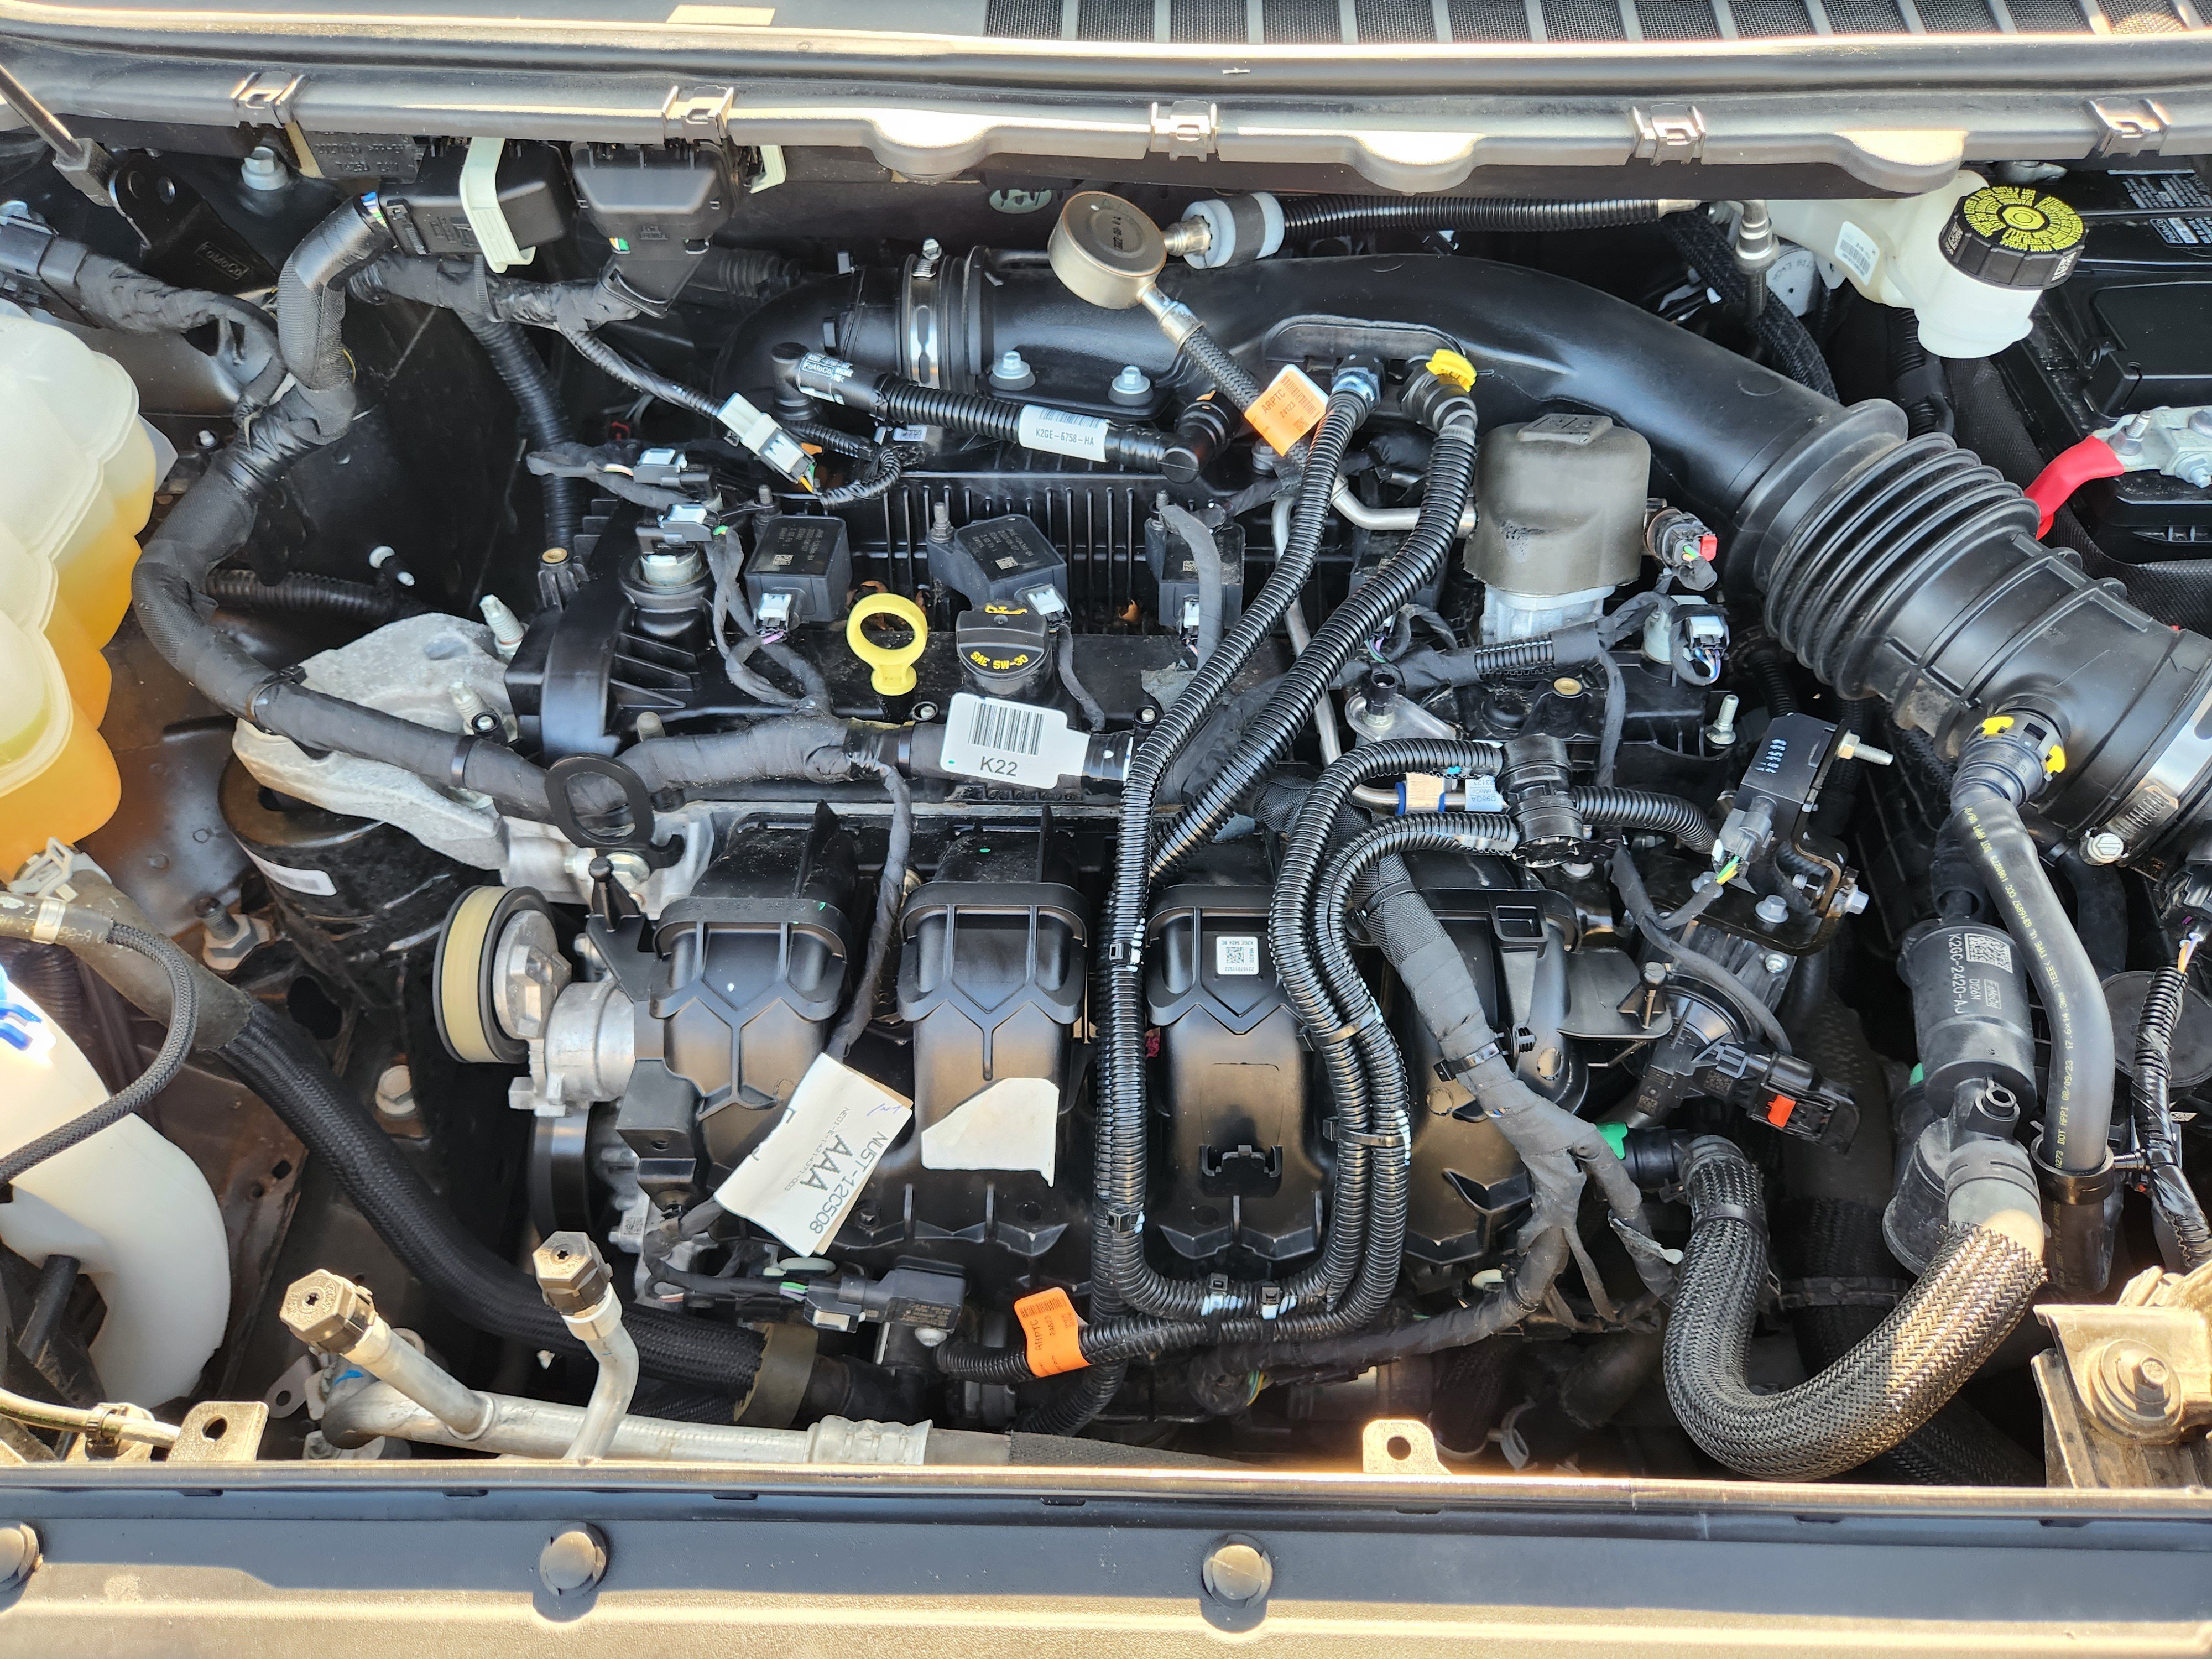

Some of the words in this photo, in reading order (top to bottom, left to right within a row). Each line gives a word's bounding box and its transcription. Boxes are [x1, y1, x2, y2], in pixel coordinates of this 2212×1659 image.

[804, 362, 832, 374] FoMoCo
[1261, 388, 1286, 414] ARPTC
[1279, 401, 1296, 418] 24123
[970, 651, 990, 667] SAE
[993, 654, 1029, 670] 5W-30
[980, 756, 1018, 777] K22
[1980, 839, 1992, 853] DOT
[2034, 941, 2047, 960] TYPE
[1987, 982, 1999, 1006] FoMoCo
[2062, 1060, 2073, 1100] 08/09/23
[2059, 1105, 2069, 1126] APPI
[2057, 1129, 2067, 1145] DOT
[800, 1134, 853, 1191] AAA
[810, 1131, 889, 1234] NU5T-12C508
[1030, 1319, 1043, 1350] ARPTC
